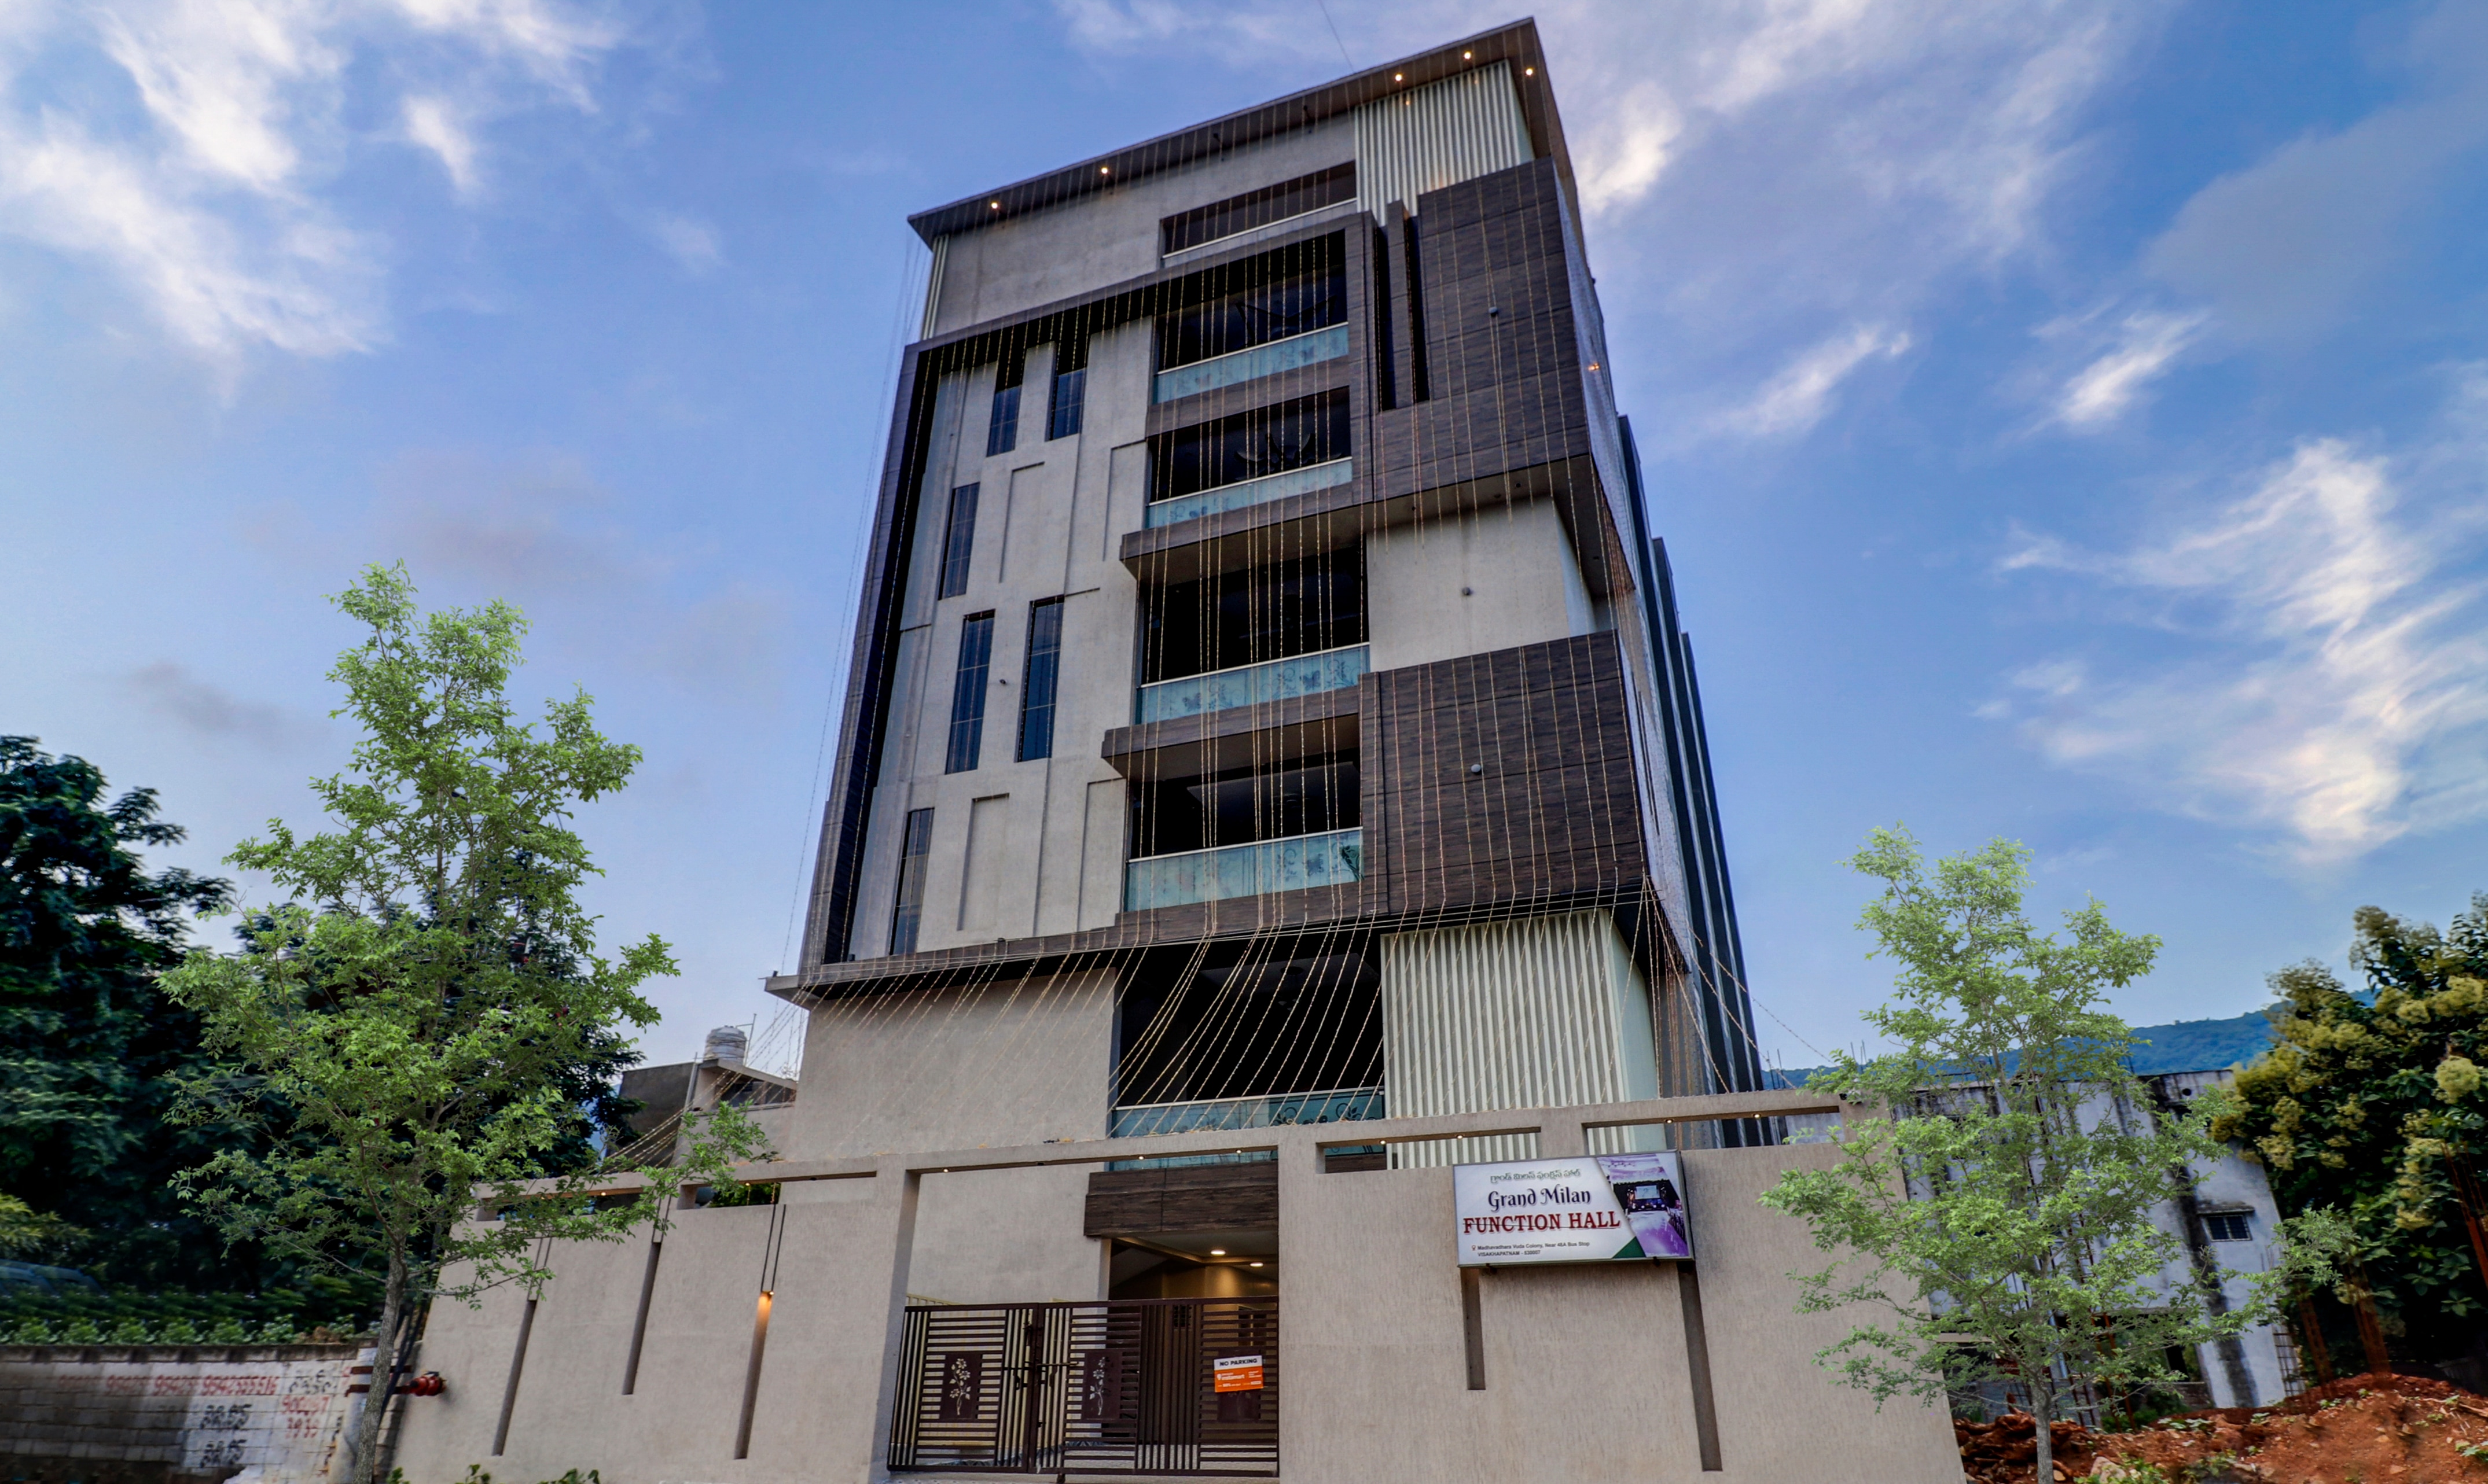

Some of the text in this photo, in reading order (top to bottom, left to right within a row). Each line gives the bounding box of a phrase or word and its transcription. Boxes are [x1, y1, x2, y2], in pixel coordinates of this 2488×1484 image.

[1488, 1184, 1590, 1213] Grand Milan
[1463, 1211, 1620, 1234] FUNCTION HALL
